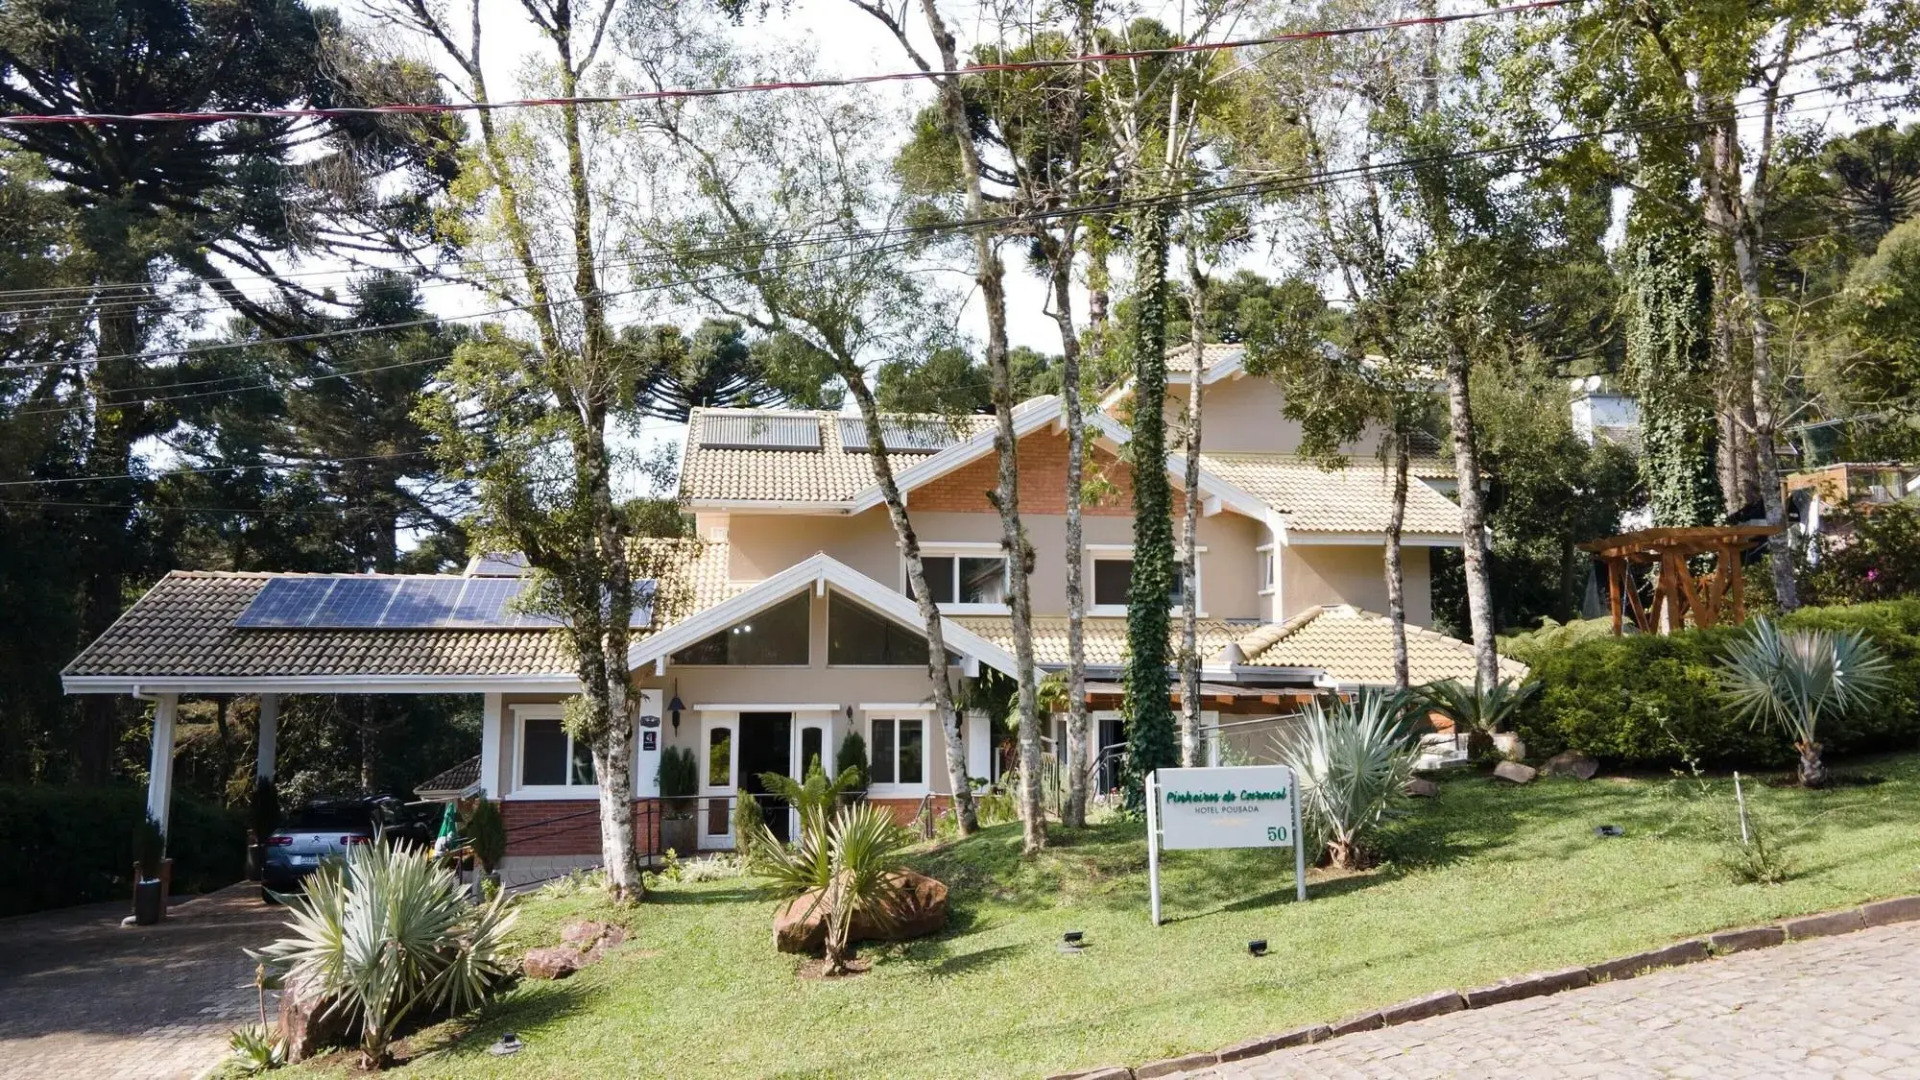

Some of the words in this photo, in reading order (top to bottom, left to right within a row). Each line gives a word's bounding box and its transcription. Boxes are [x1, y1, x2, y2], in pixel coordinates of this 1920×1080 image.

[1195, 806, 1219, 814] HOTEL
[1221, 805, 1259, 813] POUSADA
[1267, 826, 1287, 841] 50
